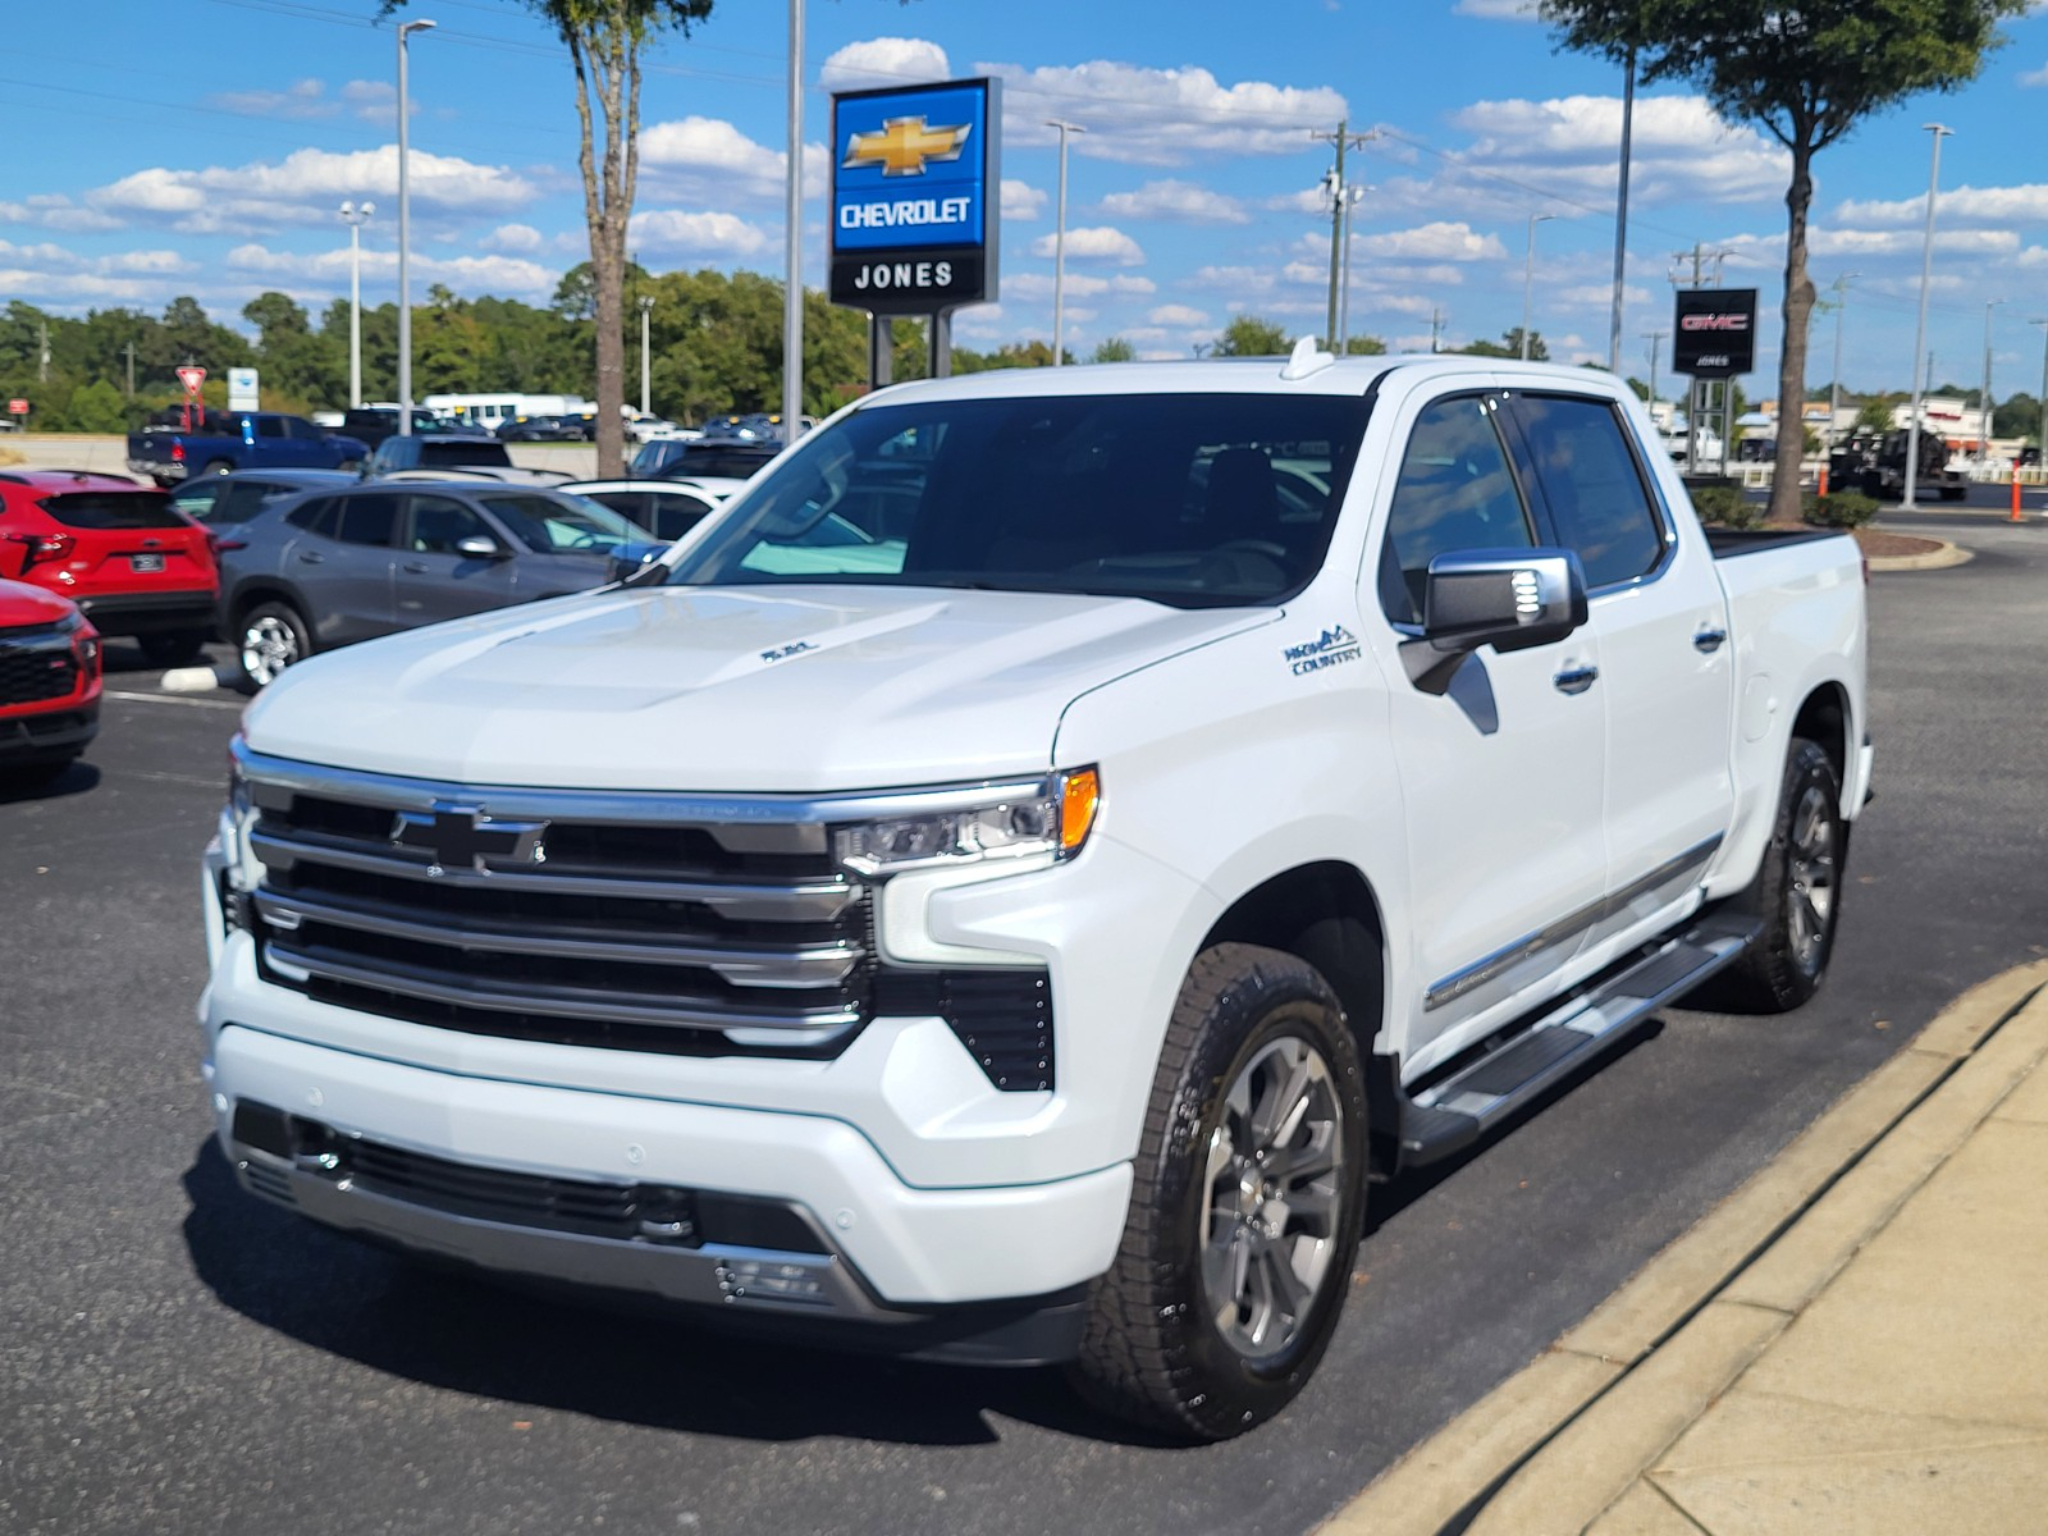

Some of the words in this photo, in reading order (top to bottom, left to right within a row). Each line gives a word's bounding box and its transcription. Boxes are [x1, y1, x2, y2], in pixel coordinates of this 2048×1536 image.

[840, 197, 971, 229] CHEVROLET
[855, 261, 952, 289] JONES
[1681, 313, 1748, 331] GMC
[1696, 355, 1730, 367] JONES
[1292, 646, 1361, 676] COUNTRY
